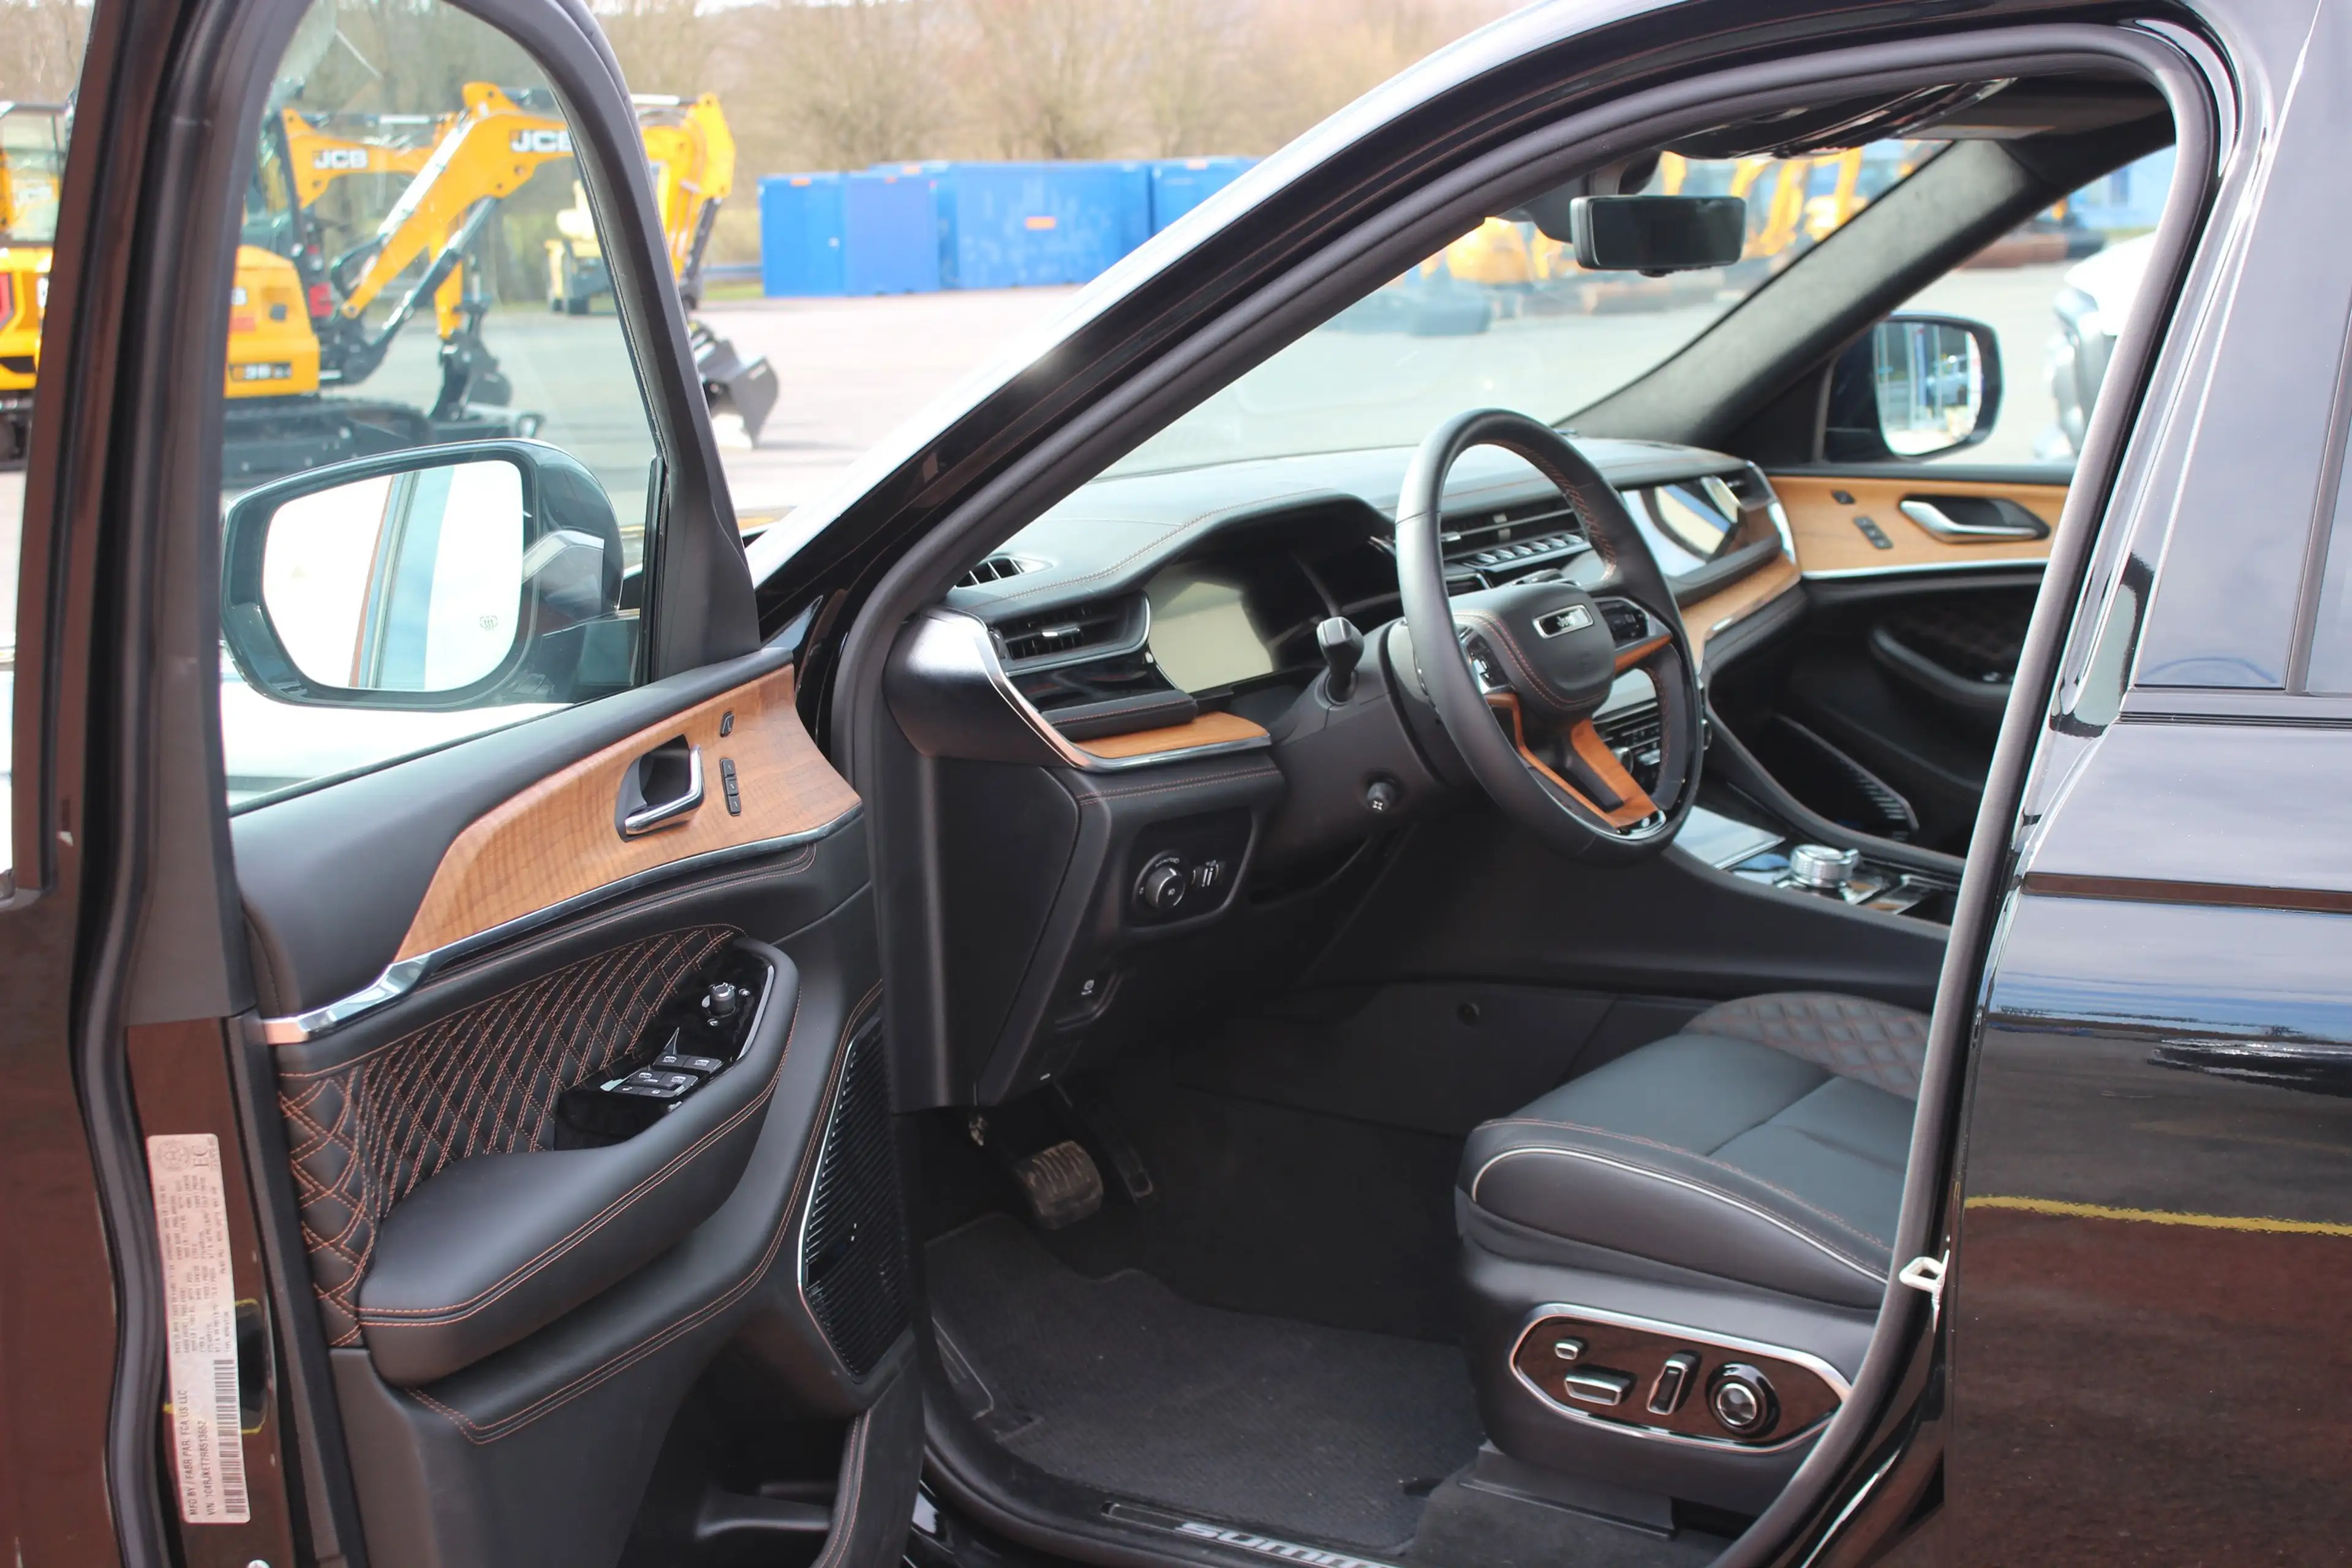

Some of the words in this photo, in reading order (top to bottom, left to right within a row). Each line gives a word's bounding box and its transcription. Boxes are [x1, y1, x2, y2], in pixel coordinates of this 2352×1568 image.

[314, 149, 368, 169] JCB
[178, 1389, 187, 1404] LLC
[179, 1406, 189, 1417] US
